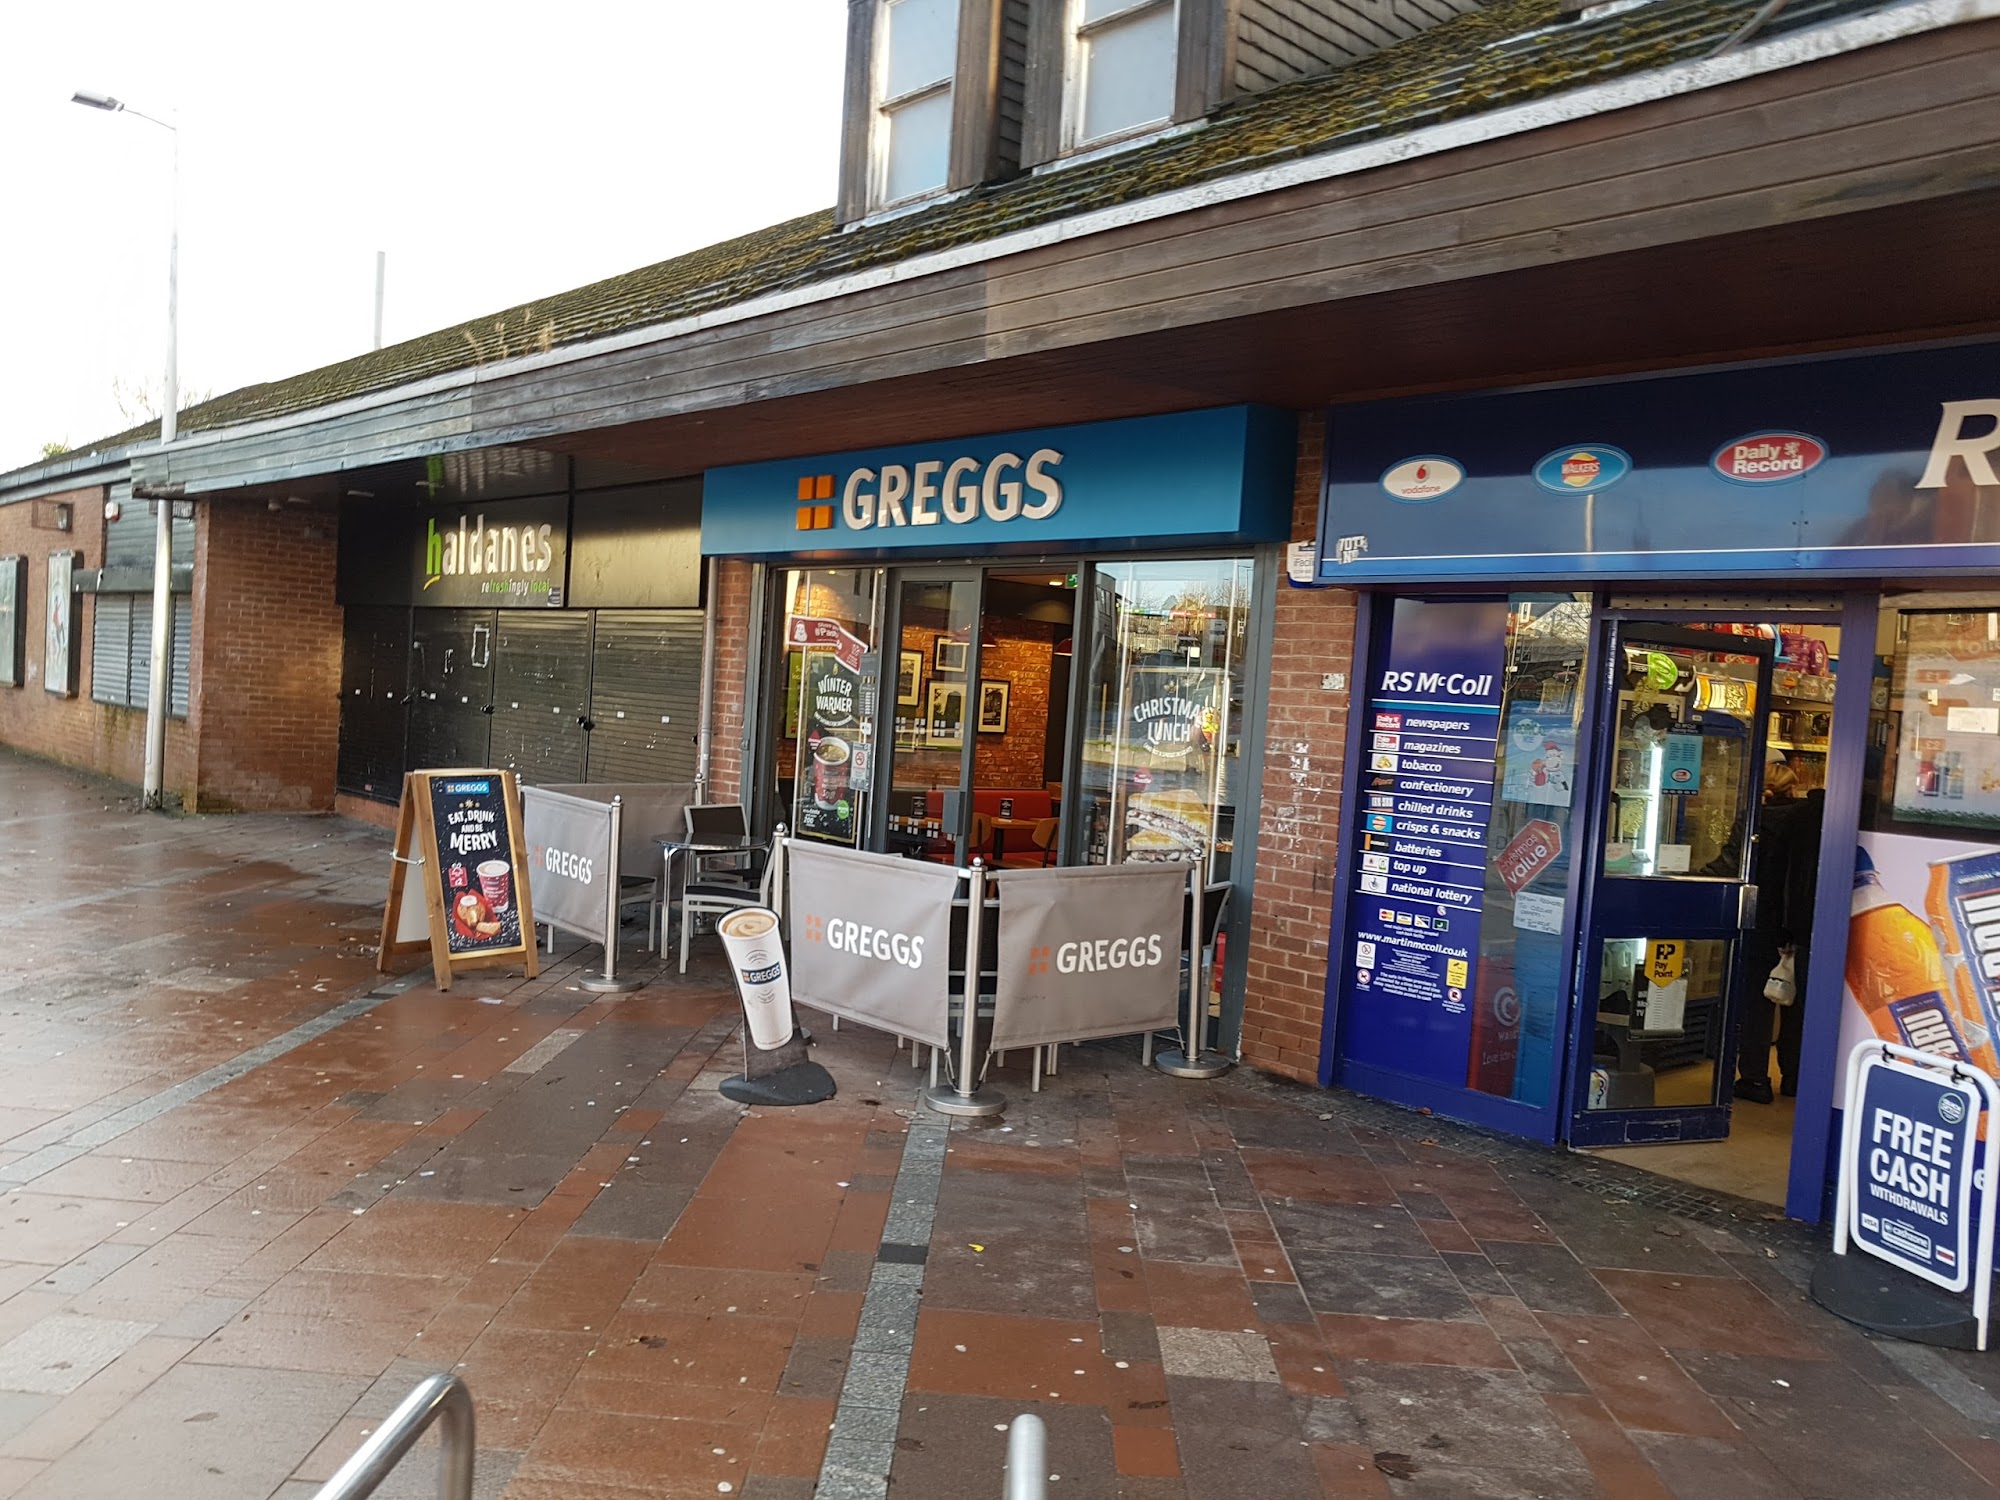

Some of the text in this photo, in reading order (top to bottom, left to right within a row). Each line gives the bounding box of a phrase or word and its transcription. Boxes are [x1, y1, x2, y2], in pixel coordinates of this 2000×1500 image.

[1733, 445, 1782, 463] Daily
[1561, 459, 1600, 476] WALKERS
[1732, 455, 1804, 475] Record
[843, 449, 1064, 530] GREGGS
[1400, 484, 1442, 495] vodafone
[425, 514, 552, 575] haldanes
[481, 578, 550, 597] refreshingly local
[817, 675, 853, 698] WINTER
[1381, 670, 1493, 696] RS McColl
[816, 696, 853, 714] WARMER
[1133, 697, 1201, 722] CHRISTMA
[1148, 722, 1191, 745] LUNCH
[1405, 718, 1470, 731] newspapers
[1403, 741, 1461, 754] magazines
[1401, 759, 1442, 772] tobacco
[455, 783, 488, 793] GREGGS
[1400, 780, 1474, 797] confectionery
[447, 810, 496, 825] EAT, DRINK
[1398, 800, 1473, 818] chilled drinks
[461, 823, 484, 832] AND BE
[1396, 820, 1481, 839] crisps & snacks
[450, 830, 498, 855] MERRY
[1395, 841, 1442, 857] batteries
[1502, 833, 1538, 873] christmas
[545, 847, 593, 885] GREGGS
[1393, 861, 1427, 875] top up
[1507, 844, 1548, 884] value
[1391, 882, 1472, 905] national lottery
[827, 918, 925, 969] GREGGS
[1357, 931, 1468, 957] www.martinmccoll.co.uk
[1056, 934, 1162, 974] GREGGS
[749, 965, 781, 983] GREGGS
[1653, 970, 1674, 978] Point
[1654, 961, 1668, 971] Pay
[1872, 1107, 1954, 1169] FREE
[1869, 1148, 1950, 1208] CASH
[1869, 1182, 1949, 1226] WITHDRAWALS
